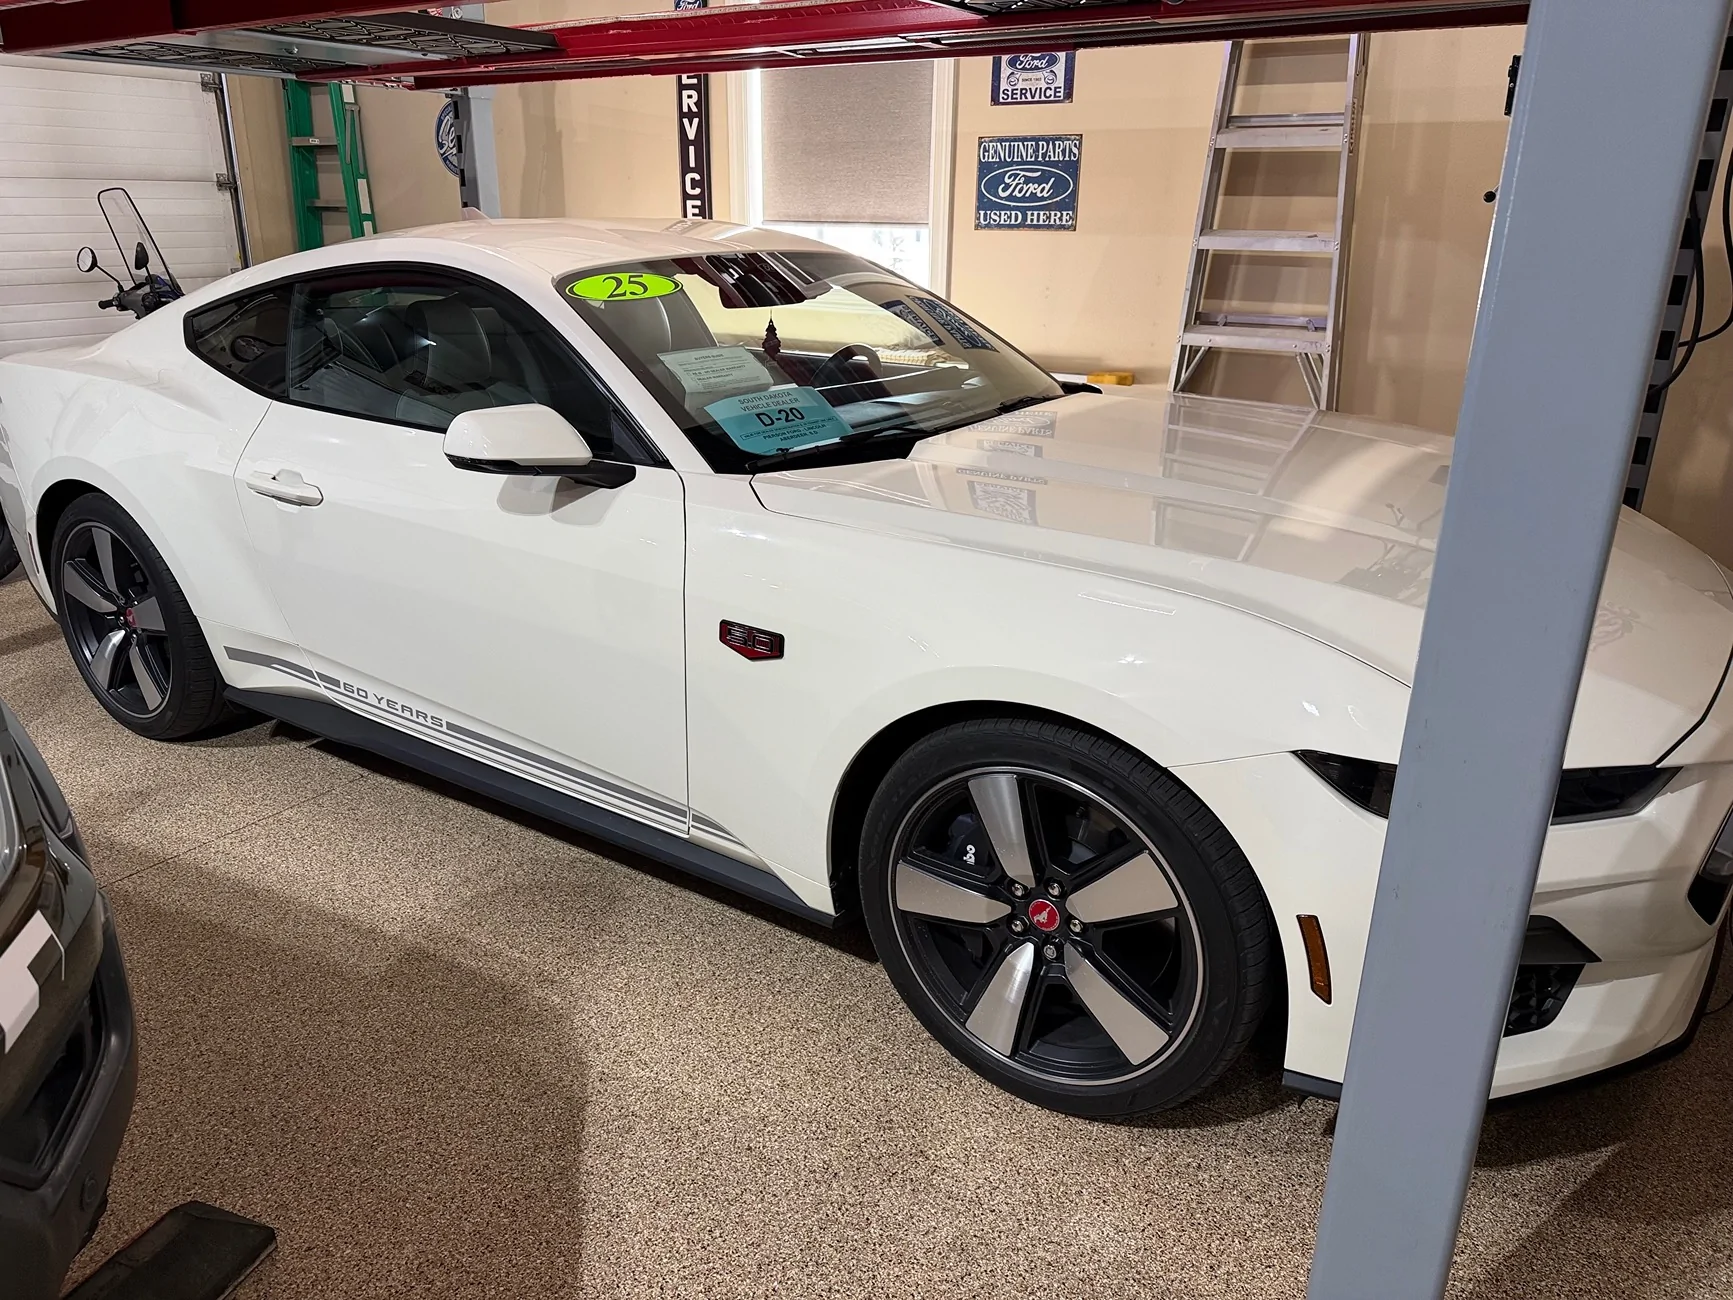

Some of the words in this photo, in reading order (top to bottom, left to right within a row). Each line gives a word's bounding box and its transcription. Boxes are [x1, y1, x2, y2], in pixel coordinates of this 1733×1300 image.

[1015, 53, 1049, 69] Ford
[1001, 86, 1062, 101] SERVICE
[979, 141, 1036, 163] GENUINE
[1038, 140, 1079, 162] PARTS
[998, 170, 1055, 198] Ford
[979, 210, 1022, 225] USED
[1025, 210, 1073, 225] HERE
[602, 274, 649, 299] 25
[738, 396, 763, 405] SOUTH
[764, 391, 793, 401] DAKOTA
[741, 402, 772, 412] VEHICLE
[773, 398, 800, 407] DEALER
[755, 407, 805, 427] D-20
[727, 625, 774, 655] 5.0
[343, 682, 368, 700] 60
[372, 692, 444, 728] YEARS
